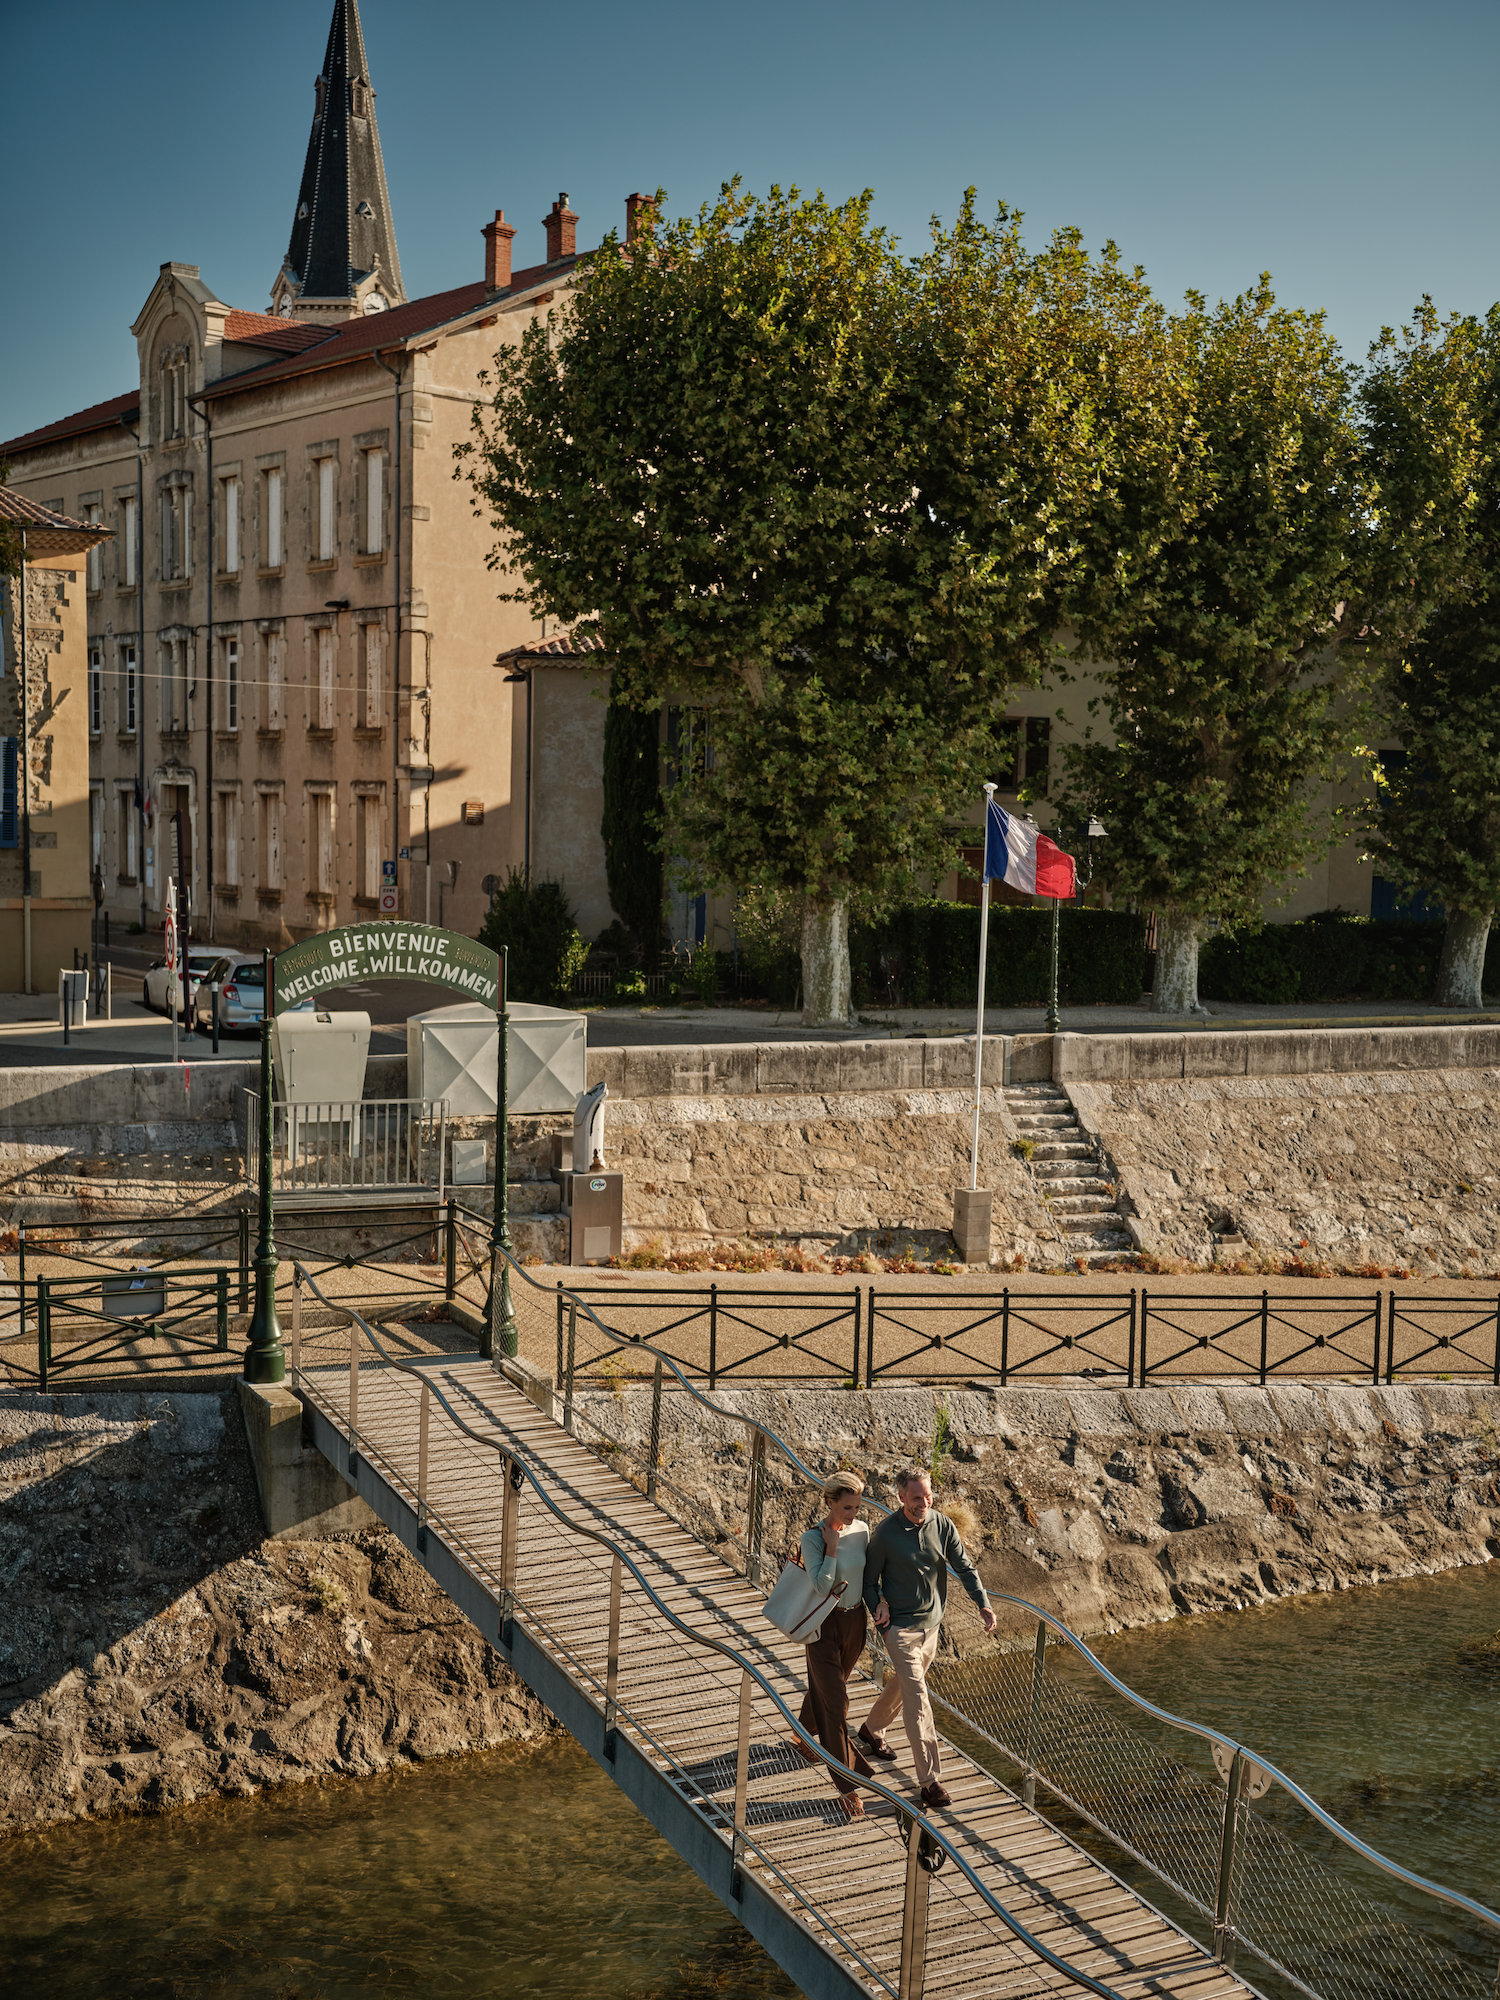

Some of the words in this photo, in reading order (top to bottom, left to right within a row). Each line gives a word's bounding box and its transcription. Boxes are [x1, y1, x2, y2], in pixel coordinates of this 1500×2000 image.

[167, 932, 174, 954] 30
[281, 948, 324, 977] BENVENUTO
[455, 948, 491, 971] BENVENUTO
